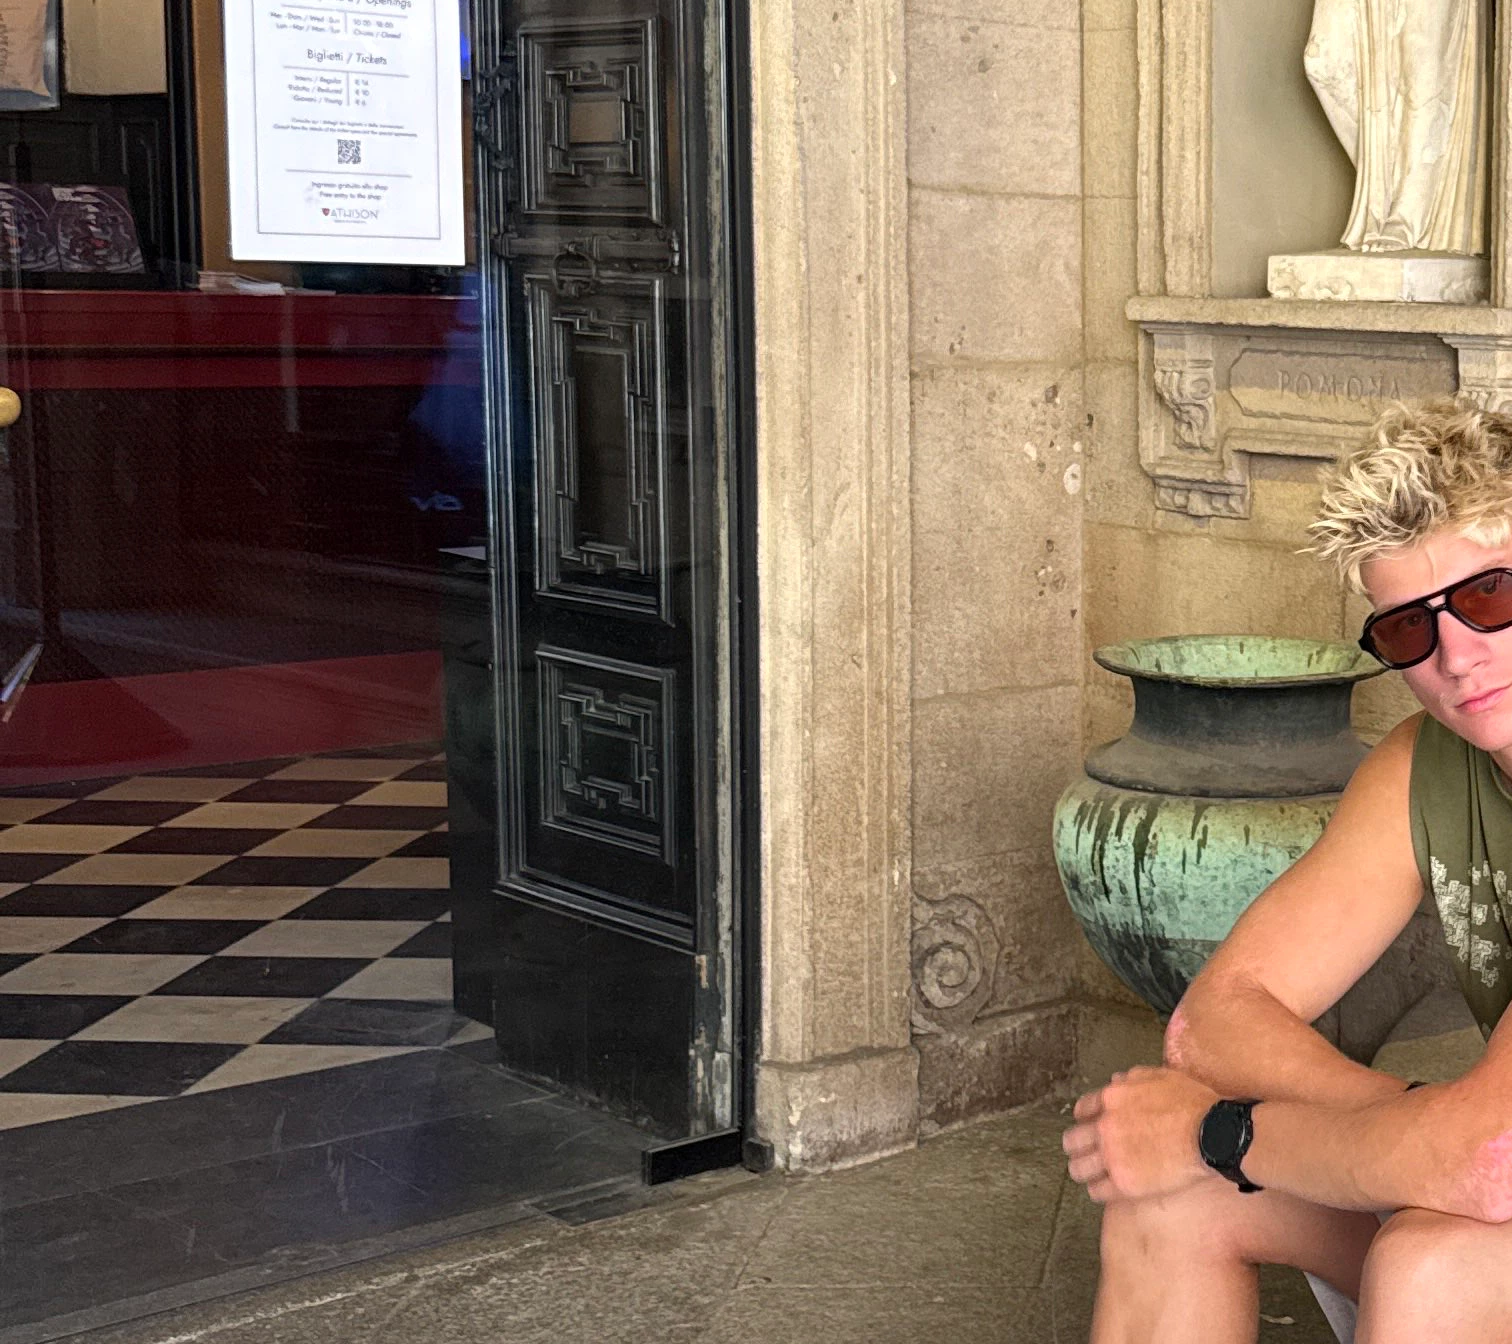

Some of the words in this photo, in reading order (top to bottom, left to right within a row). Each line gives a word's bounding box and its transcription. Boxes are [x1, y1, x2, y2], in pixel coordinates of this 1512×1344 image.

[307, 48, 344, 63] Biglietti
[355, 52, 388, 65] Tickets
[1277, 369, 1401, 404] POMONA
